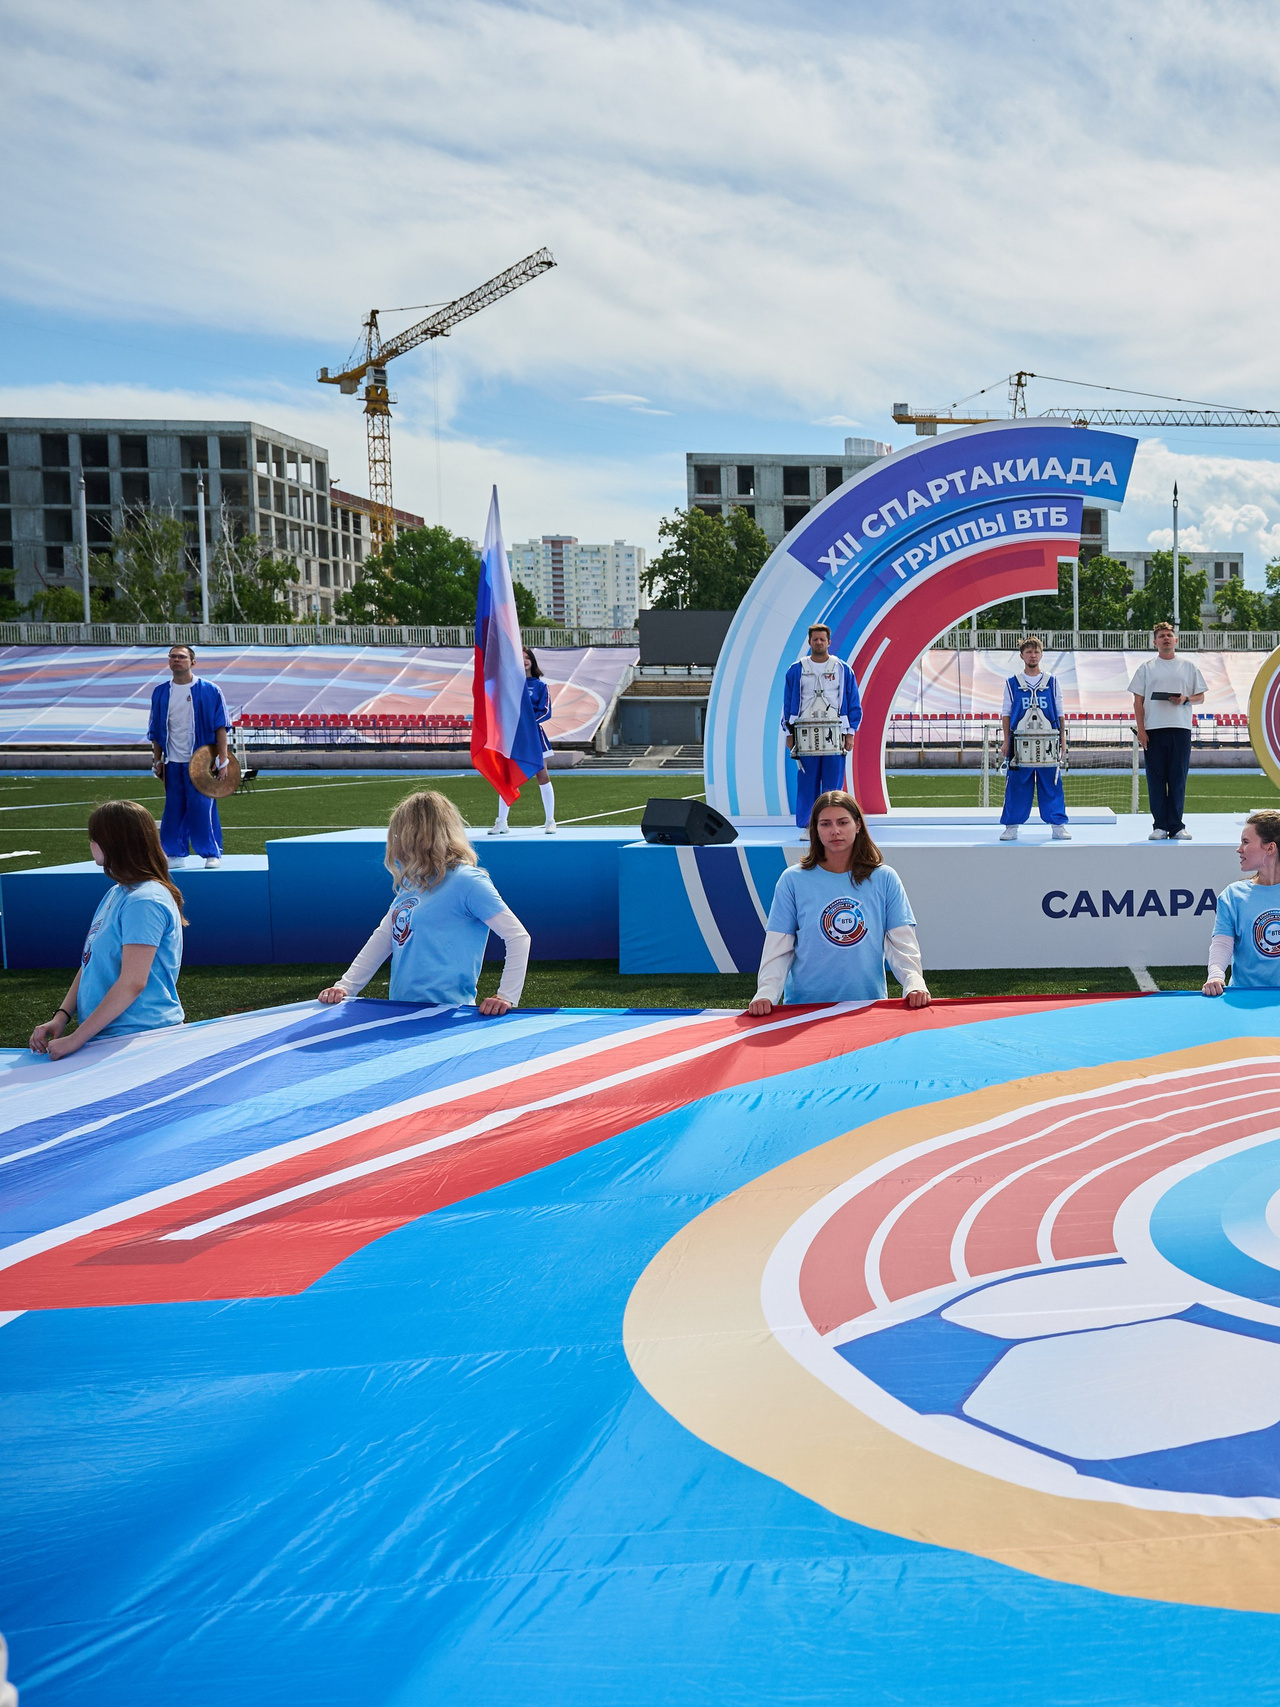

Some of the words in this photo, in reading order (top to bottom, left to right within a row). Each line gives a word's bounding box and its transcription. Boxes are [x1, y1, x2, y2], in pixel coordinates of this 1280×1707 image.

[817, 532, 863, 577] XII
[861, 457, 1118, 538] СПАРТАКИАДА
[891, 513, 1007, 580] ГРУППЫ
[1013, 507, 1069, 530] ВТБ
[1041, 889, 1217, 919] САМАРА
